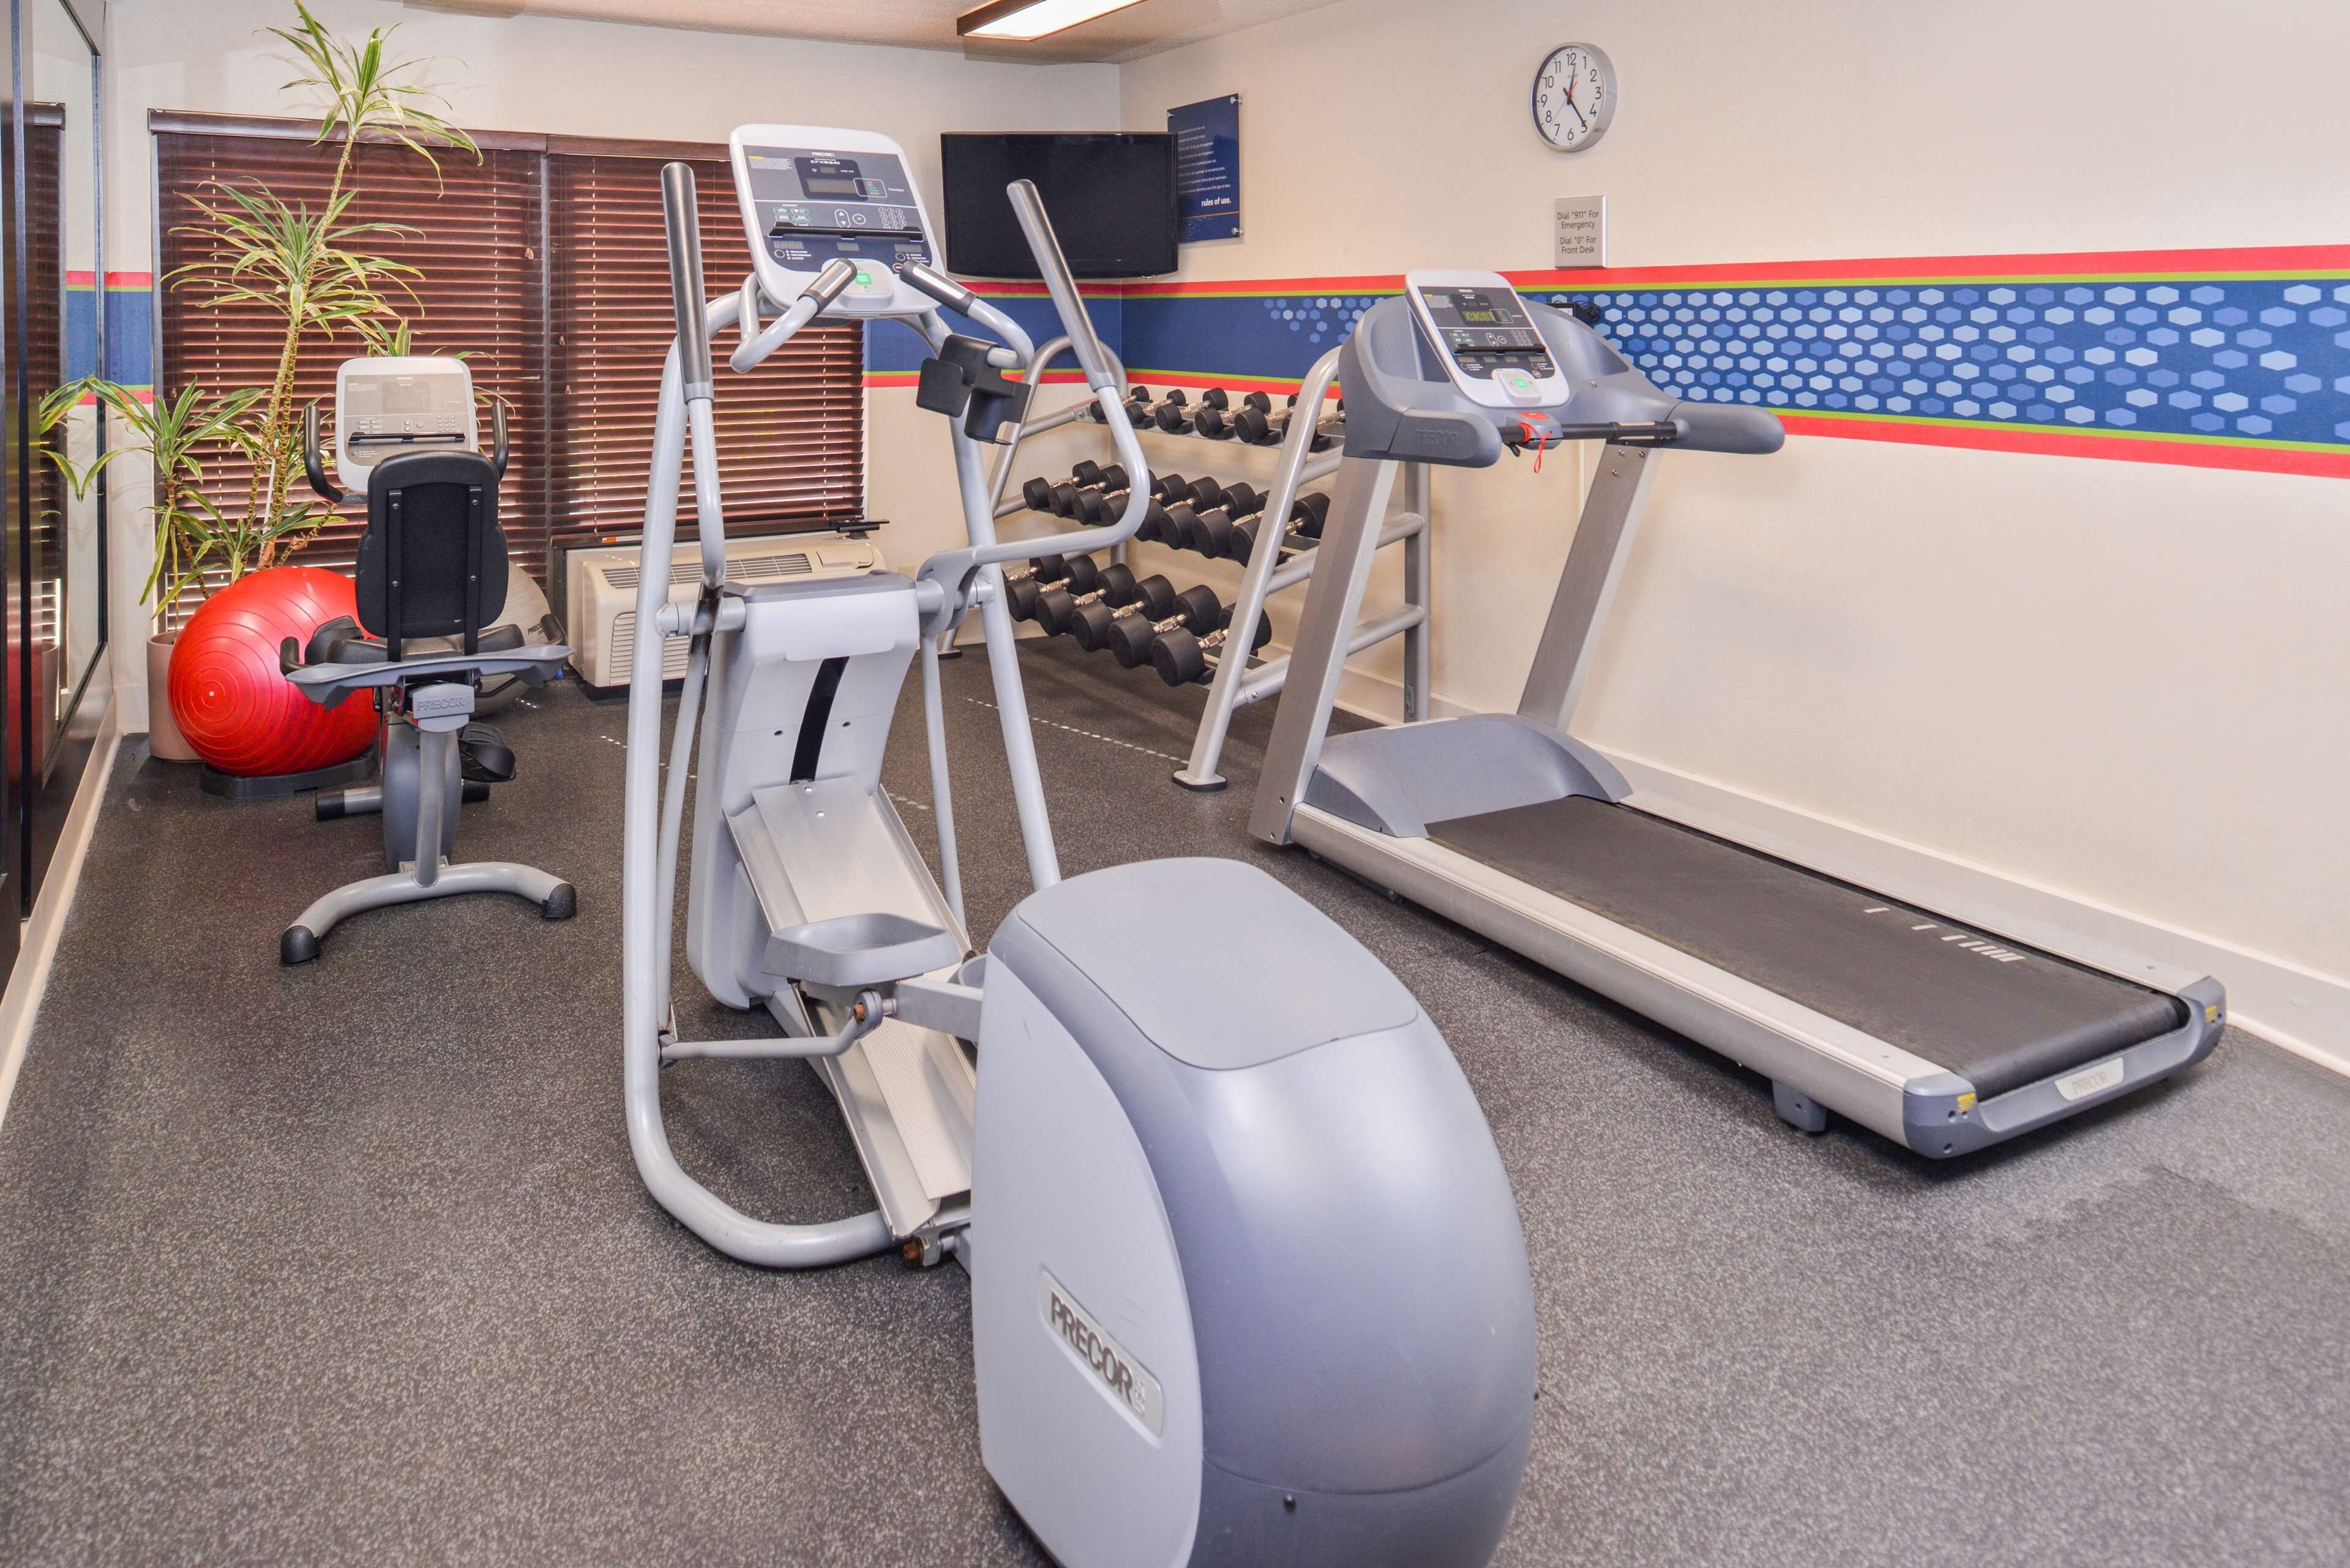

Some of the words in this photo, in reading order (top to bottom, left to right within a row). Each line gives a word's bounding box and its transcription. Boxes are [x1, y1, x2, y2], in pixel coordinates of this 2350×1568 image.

[1566, 53, 1576, 66] 12
[1583, 56, 1587, 69] 1
[1554, 61, 1561, 73] 11
[1544, 75, 1554, 89] 10
[1590, 69, 1597, 82] 2
[1595, 86, 1602, 100] 3
[1541, 94, 1547, 107] 9
[1546, 110, 1552, 122] 8
[1590, 103, 1597, 117] 4
[1554, 124, 1560, 136] 7
[1581, 120, 1587, 133] 5
[1567, 128, 1574, 141] 6
[1201, 198, 1213, 207] rules
[1214, 196, 1220, 206] of
[1557, 211, 1569, 220] Dial
[1562, 221, 1596, 230] Emergency
[1560, 236, 1572, 245] Dial
[1574, 236, 1584, 244] "0"
[1579, 245, 1595, 254] Desk
[417, 697, 465, 711] PRECOR
[1050, 1291, 1132, 1405] PRECOR
